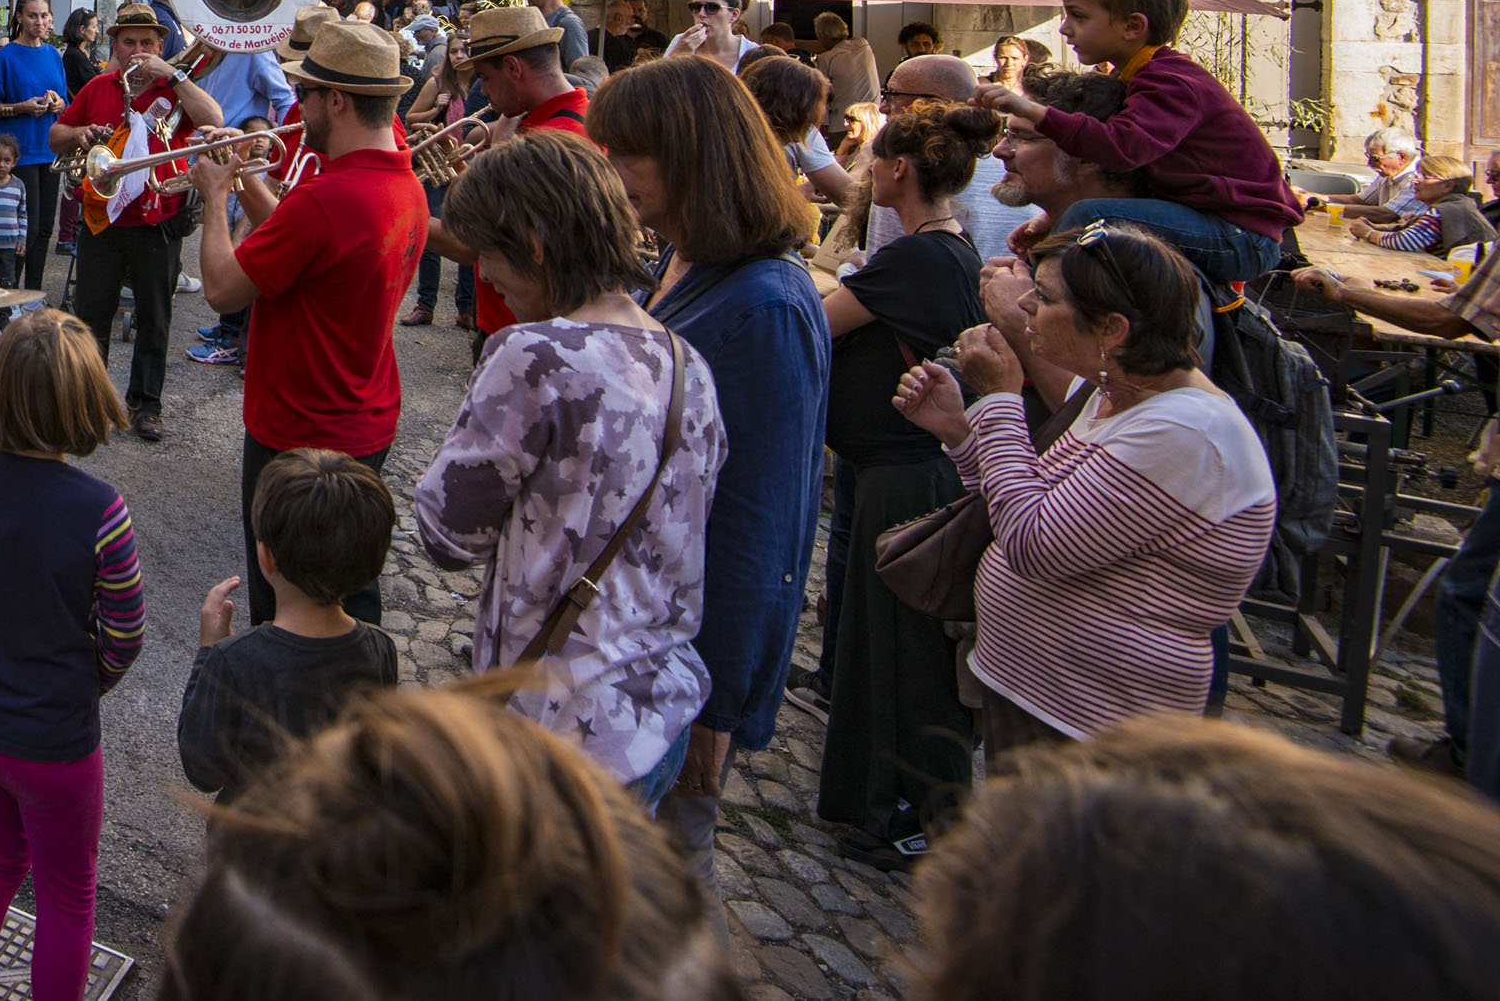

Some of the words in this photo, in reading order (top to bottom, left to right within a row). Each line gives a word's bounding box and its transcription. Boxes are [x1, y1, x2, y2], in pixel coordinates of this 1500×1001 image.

[193, 24, 204, 35] St
[203, 32, 226, 47] Jean
[229, 40, 242, 49] de
[212, 25, 224, 34] 06
[225, 25, 235, 34] 71
[236, 25, 248, 33] 50
[249, 25, 261, 33] 50
[263, 25, 274, 33] 17
